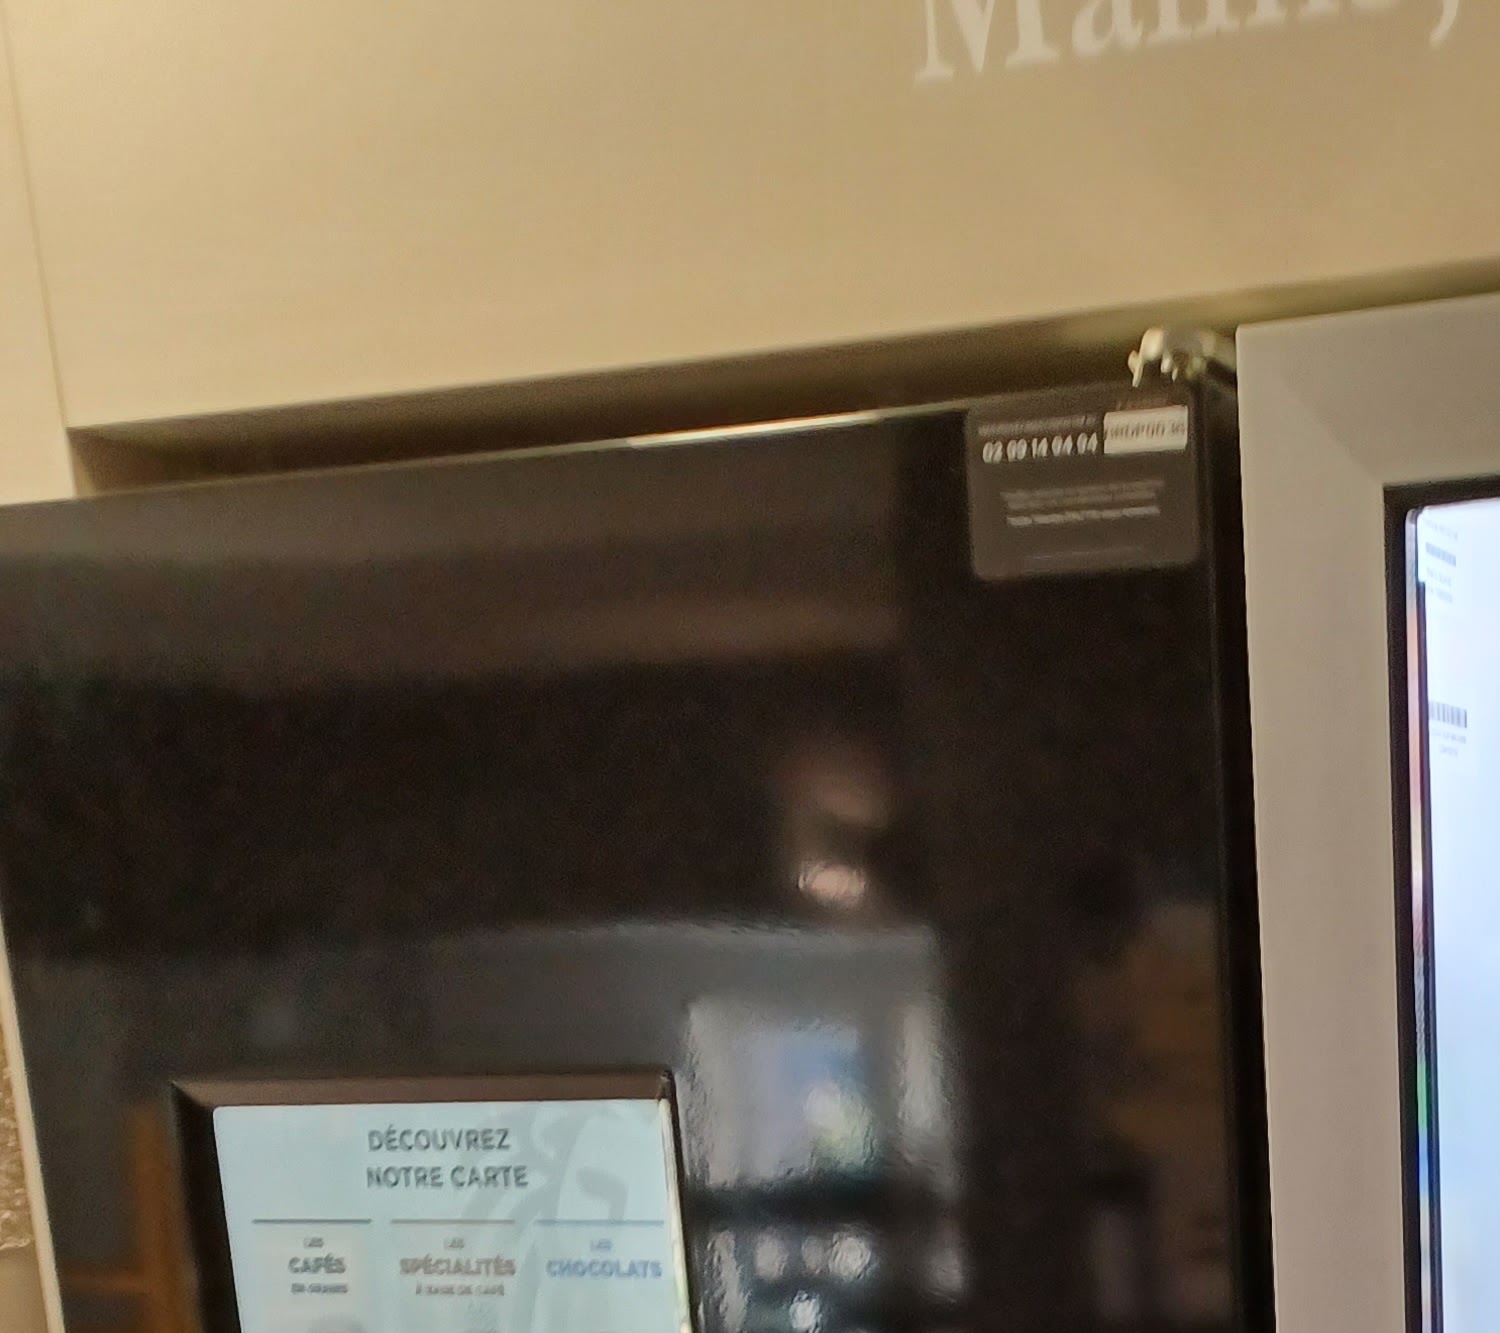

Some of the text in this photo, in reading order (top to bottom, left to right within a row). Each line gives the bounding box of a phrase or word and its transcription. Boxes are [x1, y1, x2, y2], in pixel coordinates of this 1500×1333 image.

[368, 1124, 512, 1152] DÉCOUVREZ
[366, 1164, 530, 1190] NOTRE CARTE
